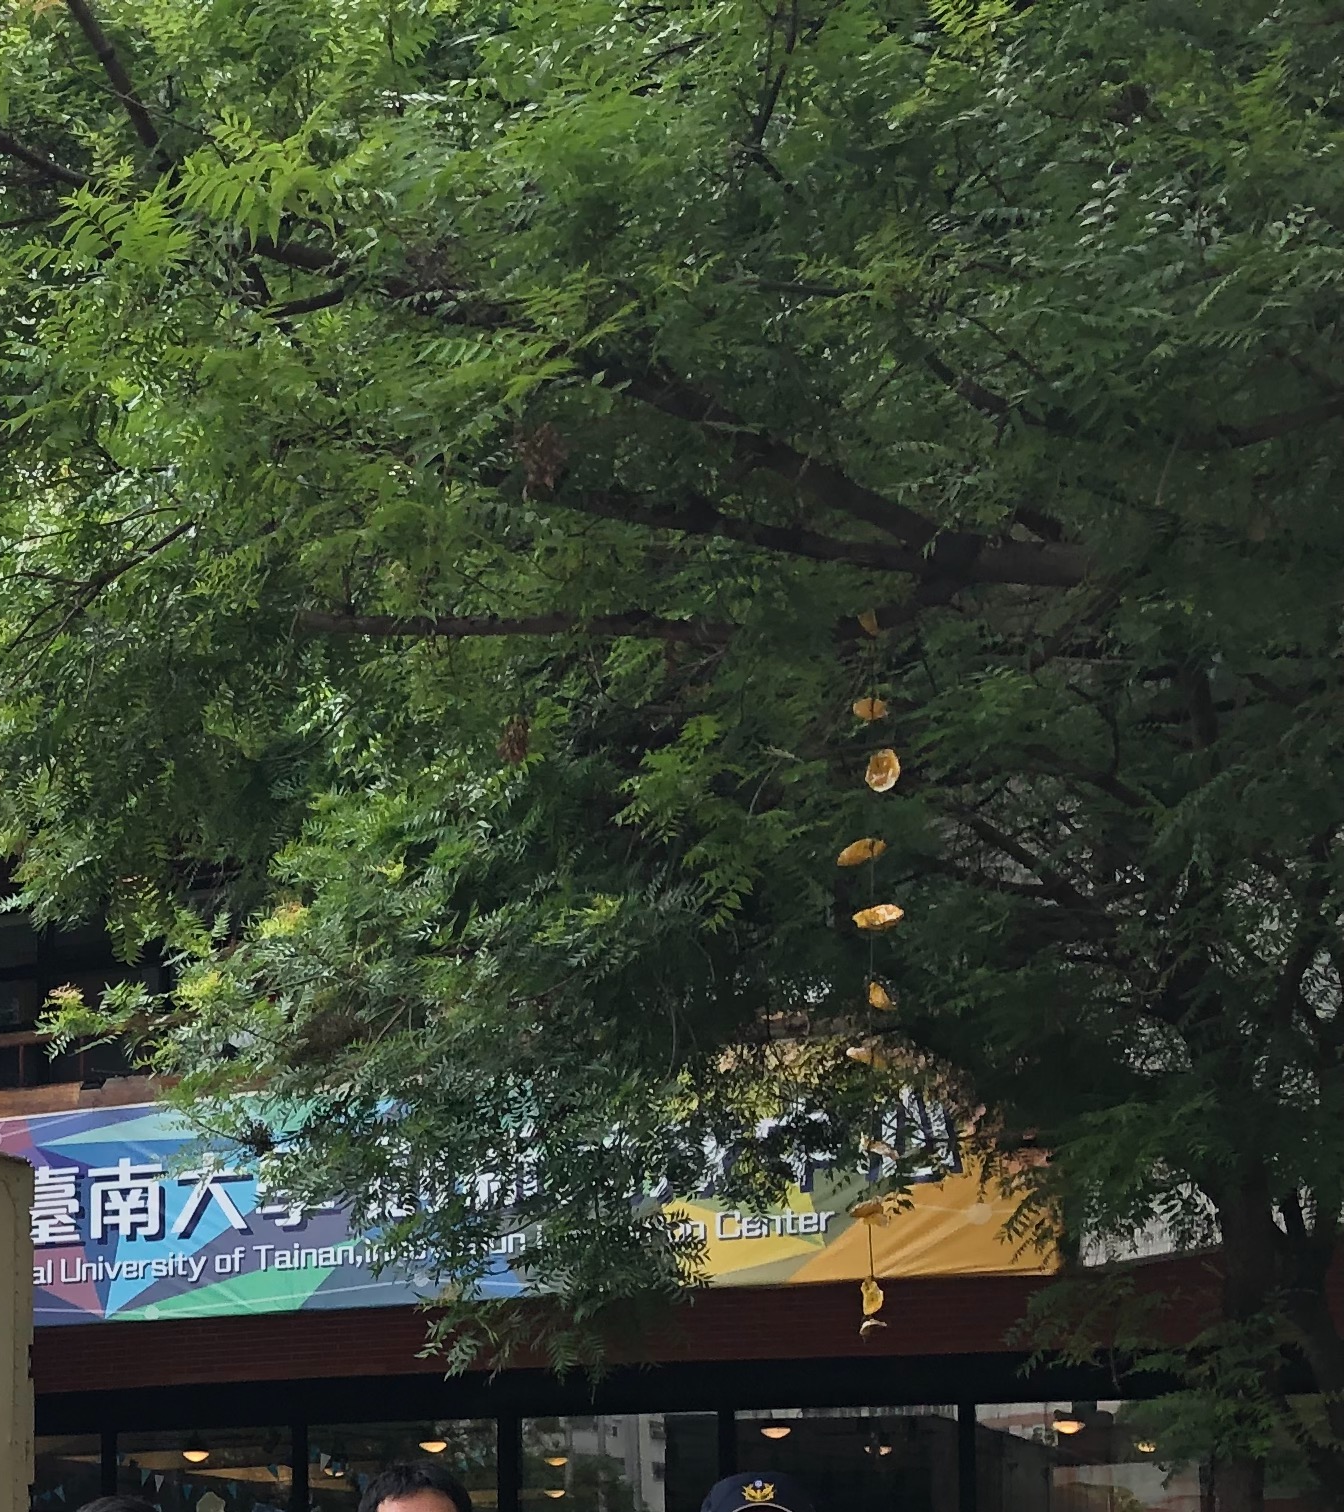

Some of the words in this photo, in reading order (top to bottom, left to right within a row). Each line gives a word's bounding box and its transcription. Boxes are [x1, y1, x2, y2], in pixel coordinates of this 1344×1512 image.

[60, 1253, 207, 1284] University
[215, 1247, 246, 1273] of
[715, 1210, 834, 1240] Center
